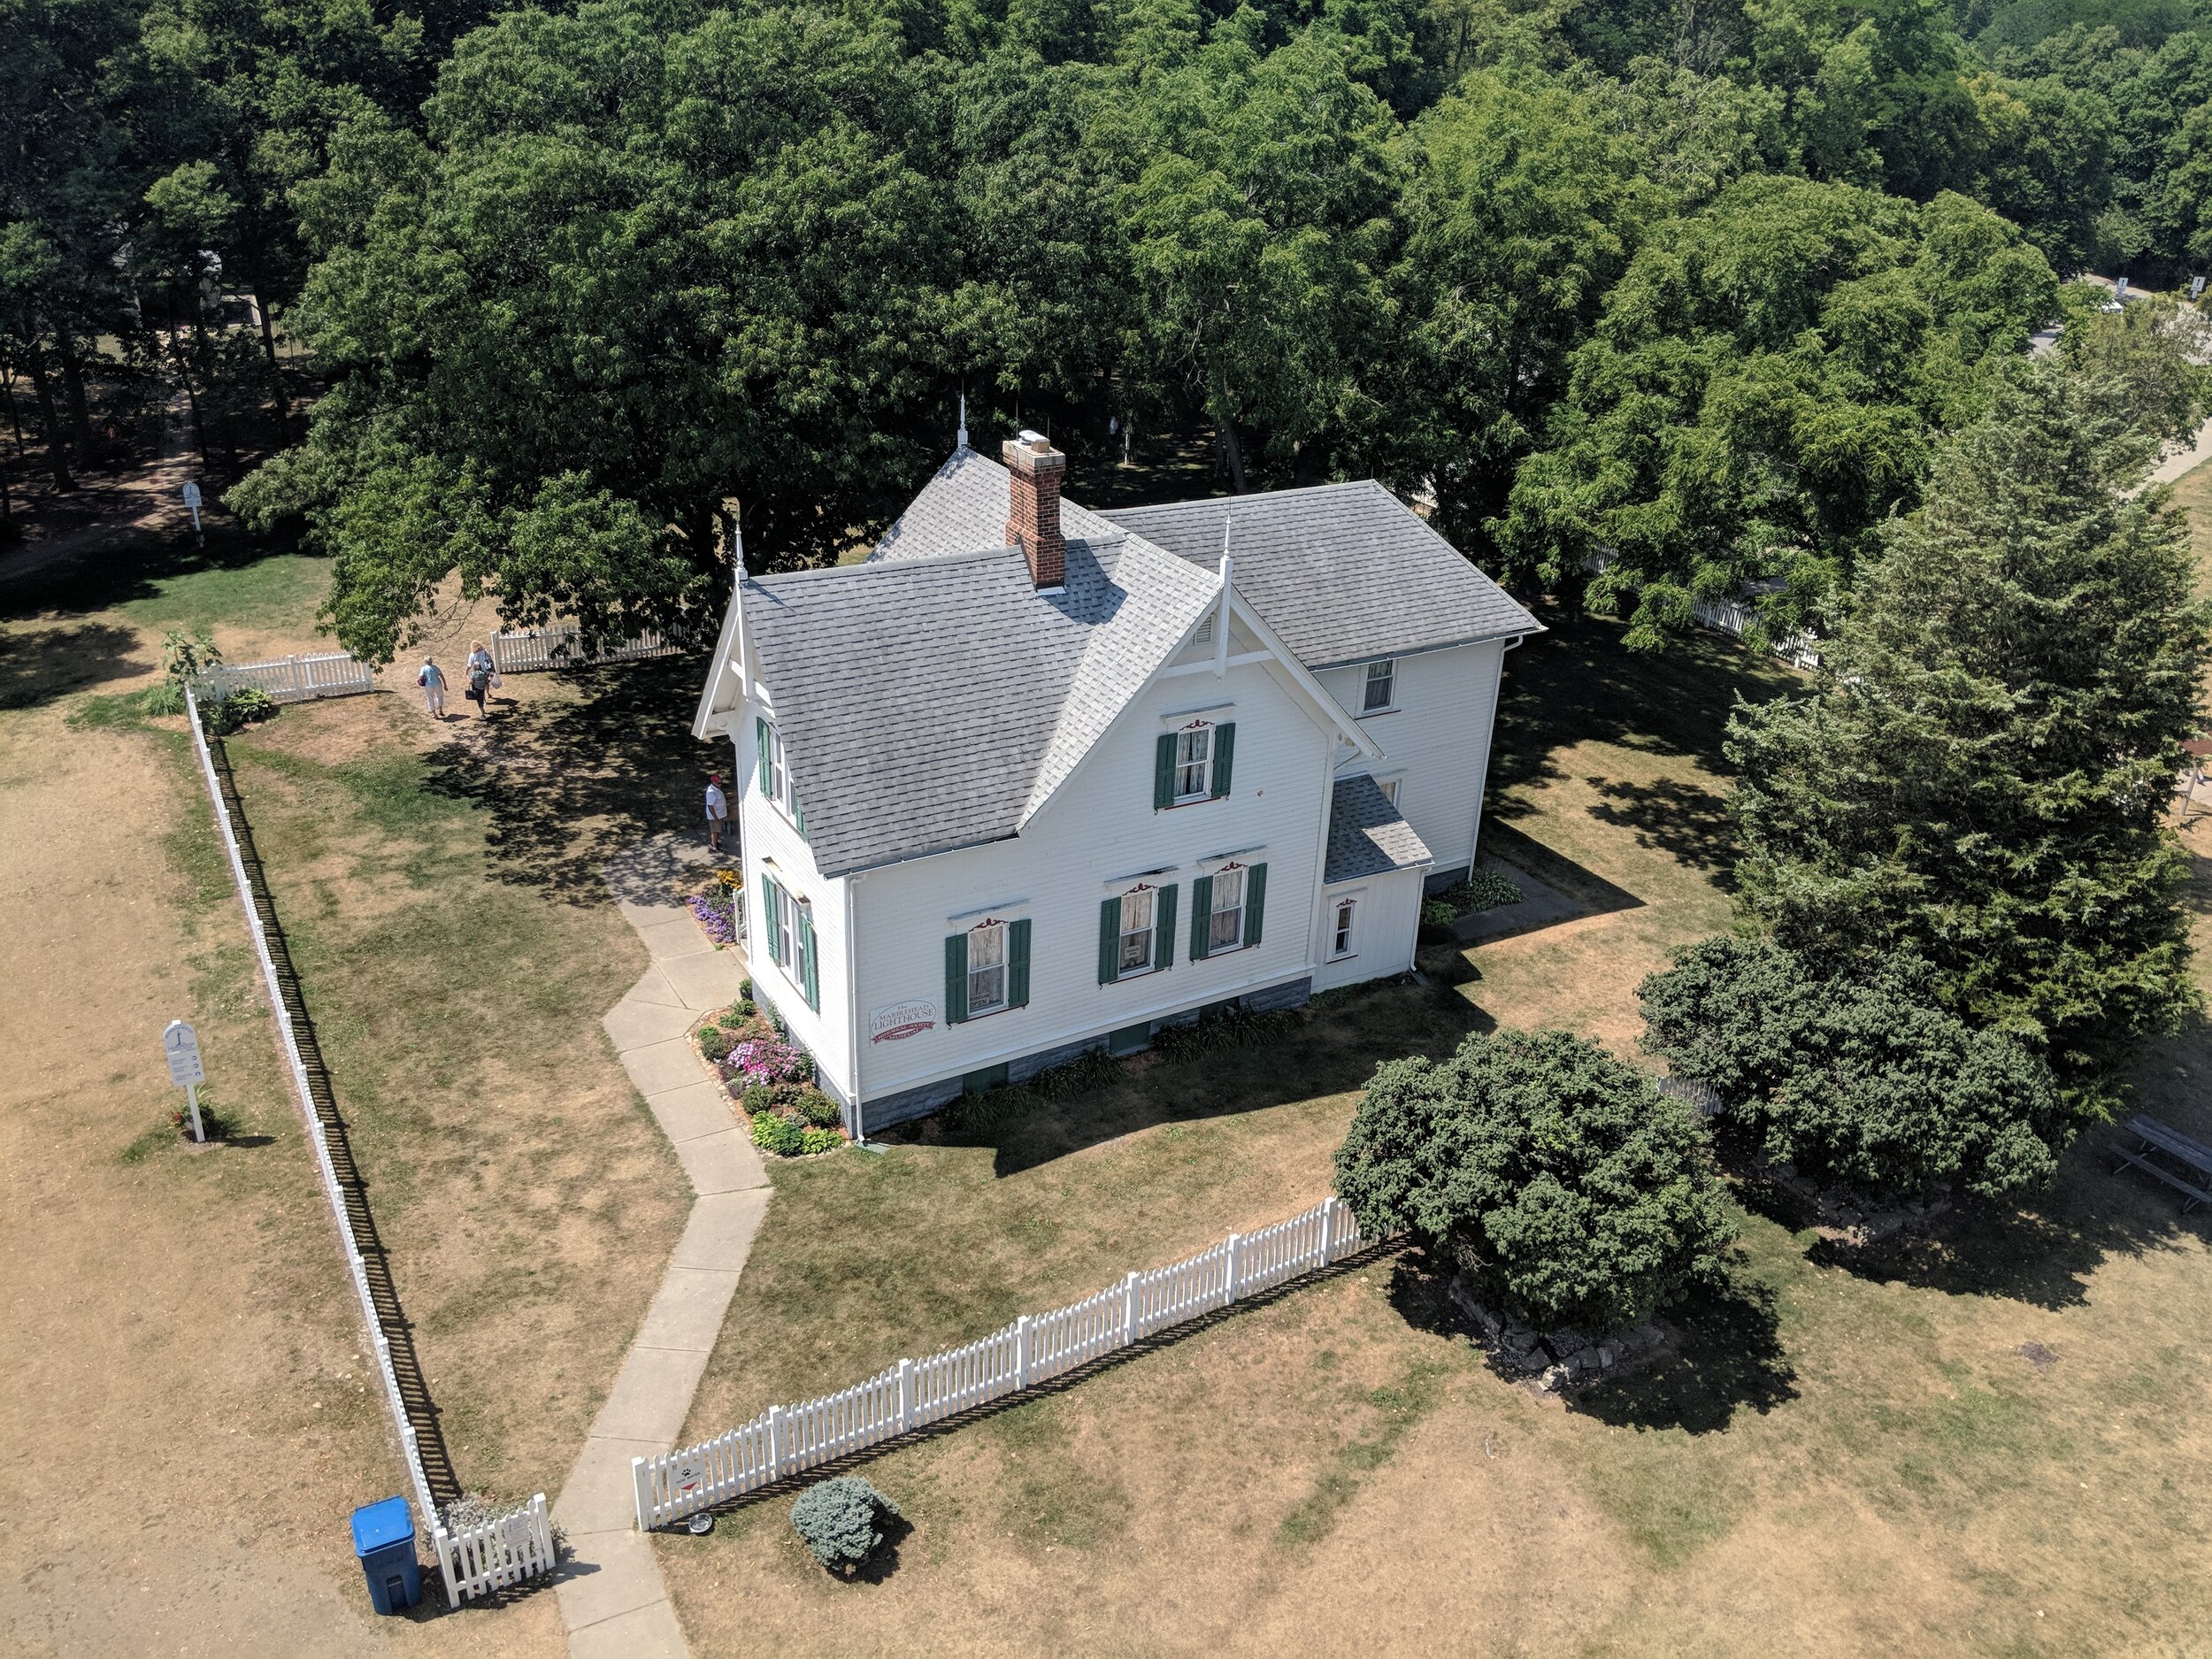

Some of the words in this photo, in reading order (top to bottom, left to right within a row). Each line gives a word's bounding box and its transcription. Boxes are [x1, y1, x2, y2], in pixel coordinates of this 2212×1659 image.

[969, 999, 987, 1008] OPEN
[874, 1009, 934, 1030] LIGHTHOUSE
[879, 1004, 929, 1020] MARBLEHEAD
[878, 1025, 907, 1040] HISTORICAL
[889, 1028, 919, 1040] MUSEUM
